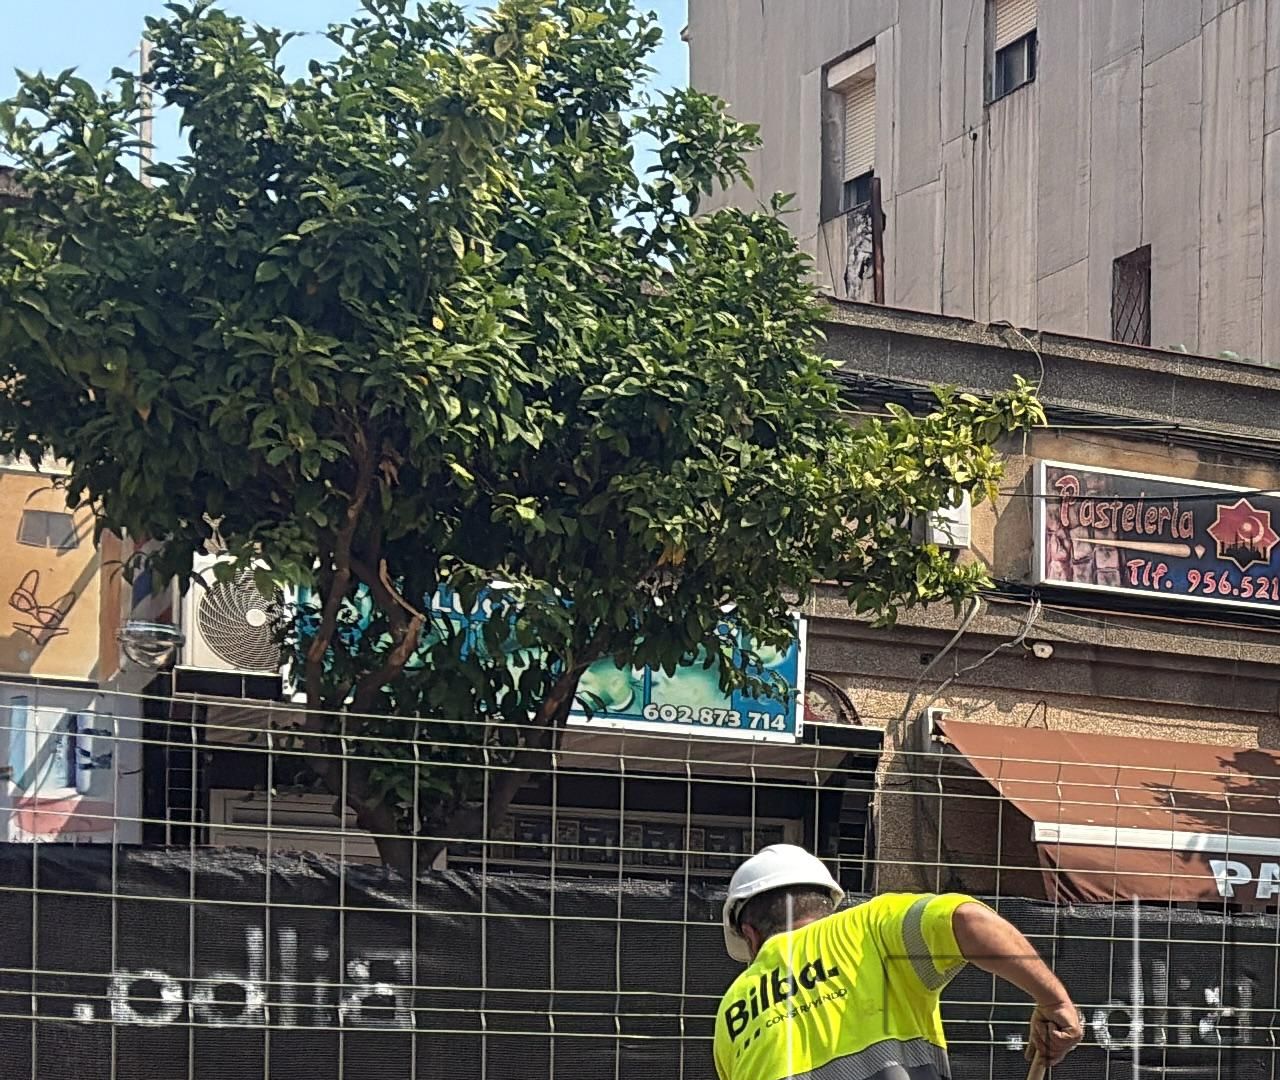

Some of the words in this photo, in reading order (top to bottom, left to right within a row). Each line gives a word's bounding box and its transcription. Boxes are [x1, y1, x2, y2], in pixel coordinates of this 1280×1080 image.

[643, 703, 693, 724] 602
[699, 708, 741, 728] 873
[748, 711, 786, 731] 714
[724, 957, 840, 1043] Bilba.
